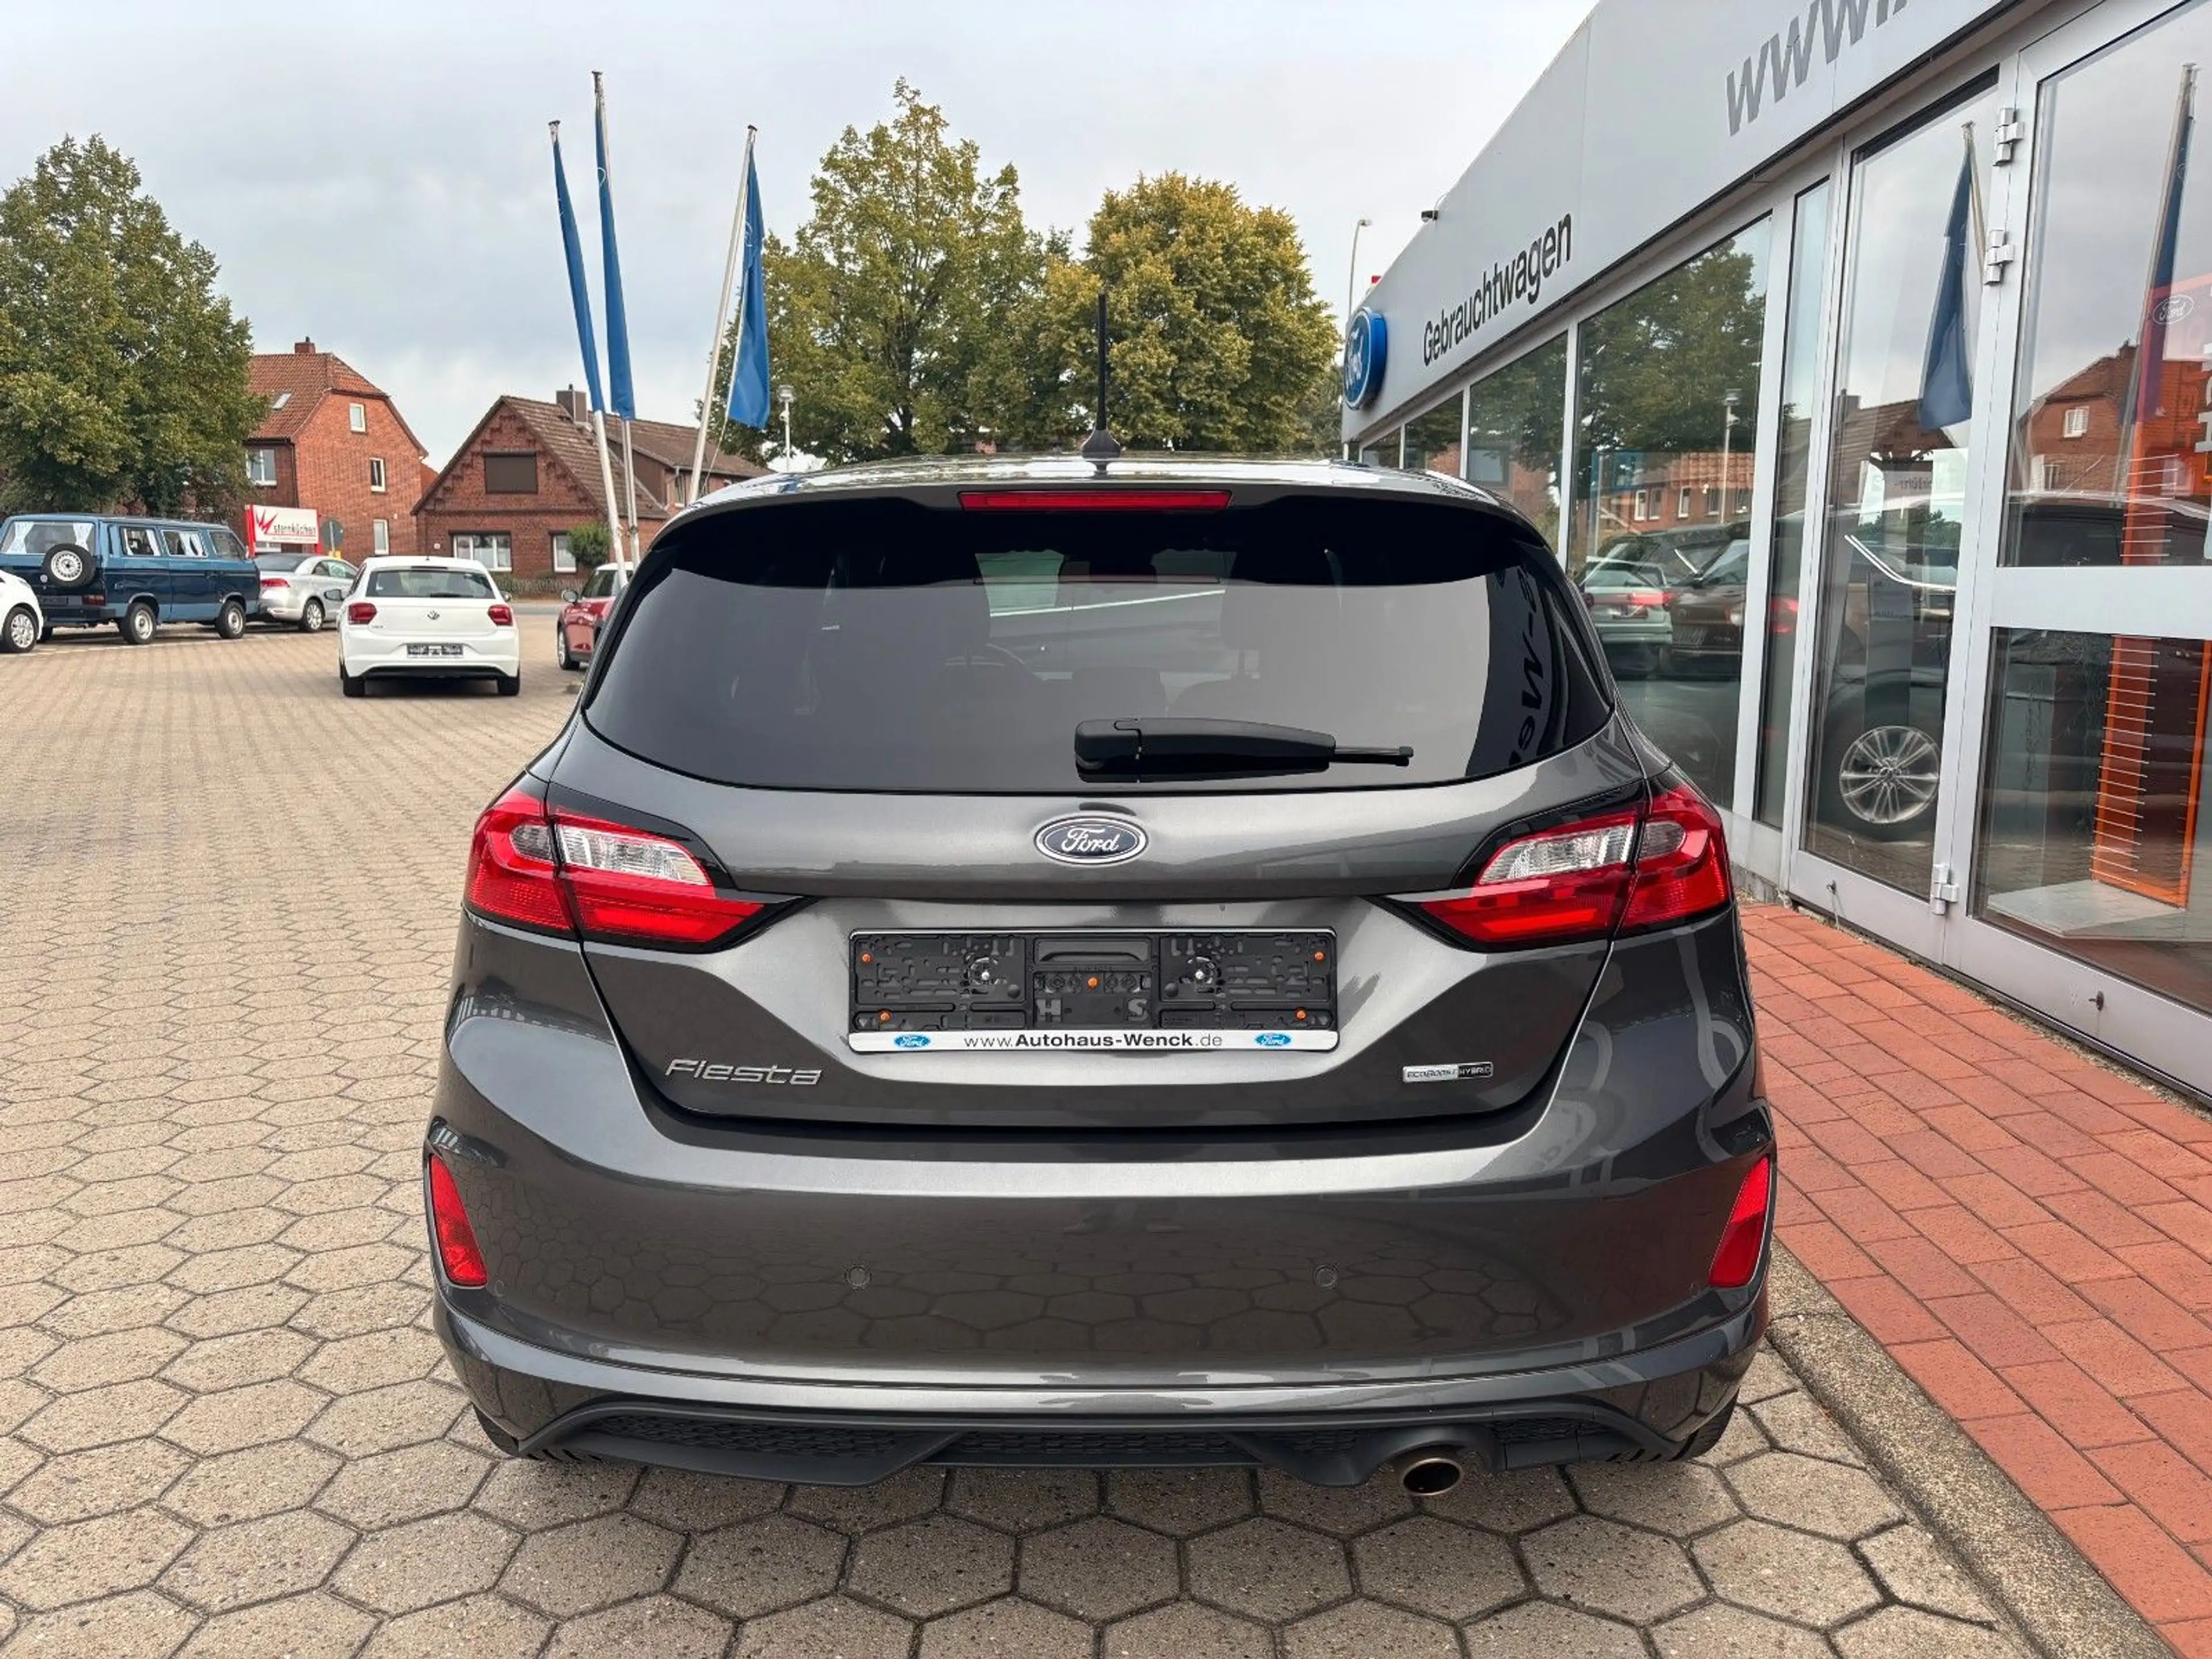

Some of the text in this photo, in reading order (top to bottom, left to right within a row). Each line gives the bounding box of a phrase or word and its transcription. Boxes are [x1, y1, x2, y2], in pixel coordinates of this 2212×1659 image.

[1423, 213, 1571, 366] Gebrauchtwagen
[1061, 827, 1121, 851] Ford
[964, 1033, 1222, 1047] www.Autohaus-Wenck.de
[665, 1059, 823, 1085] Fiesta
